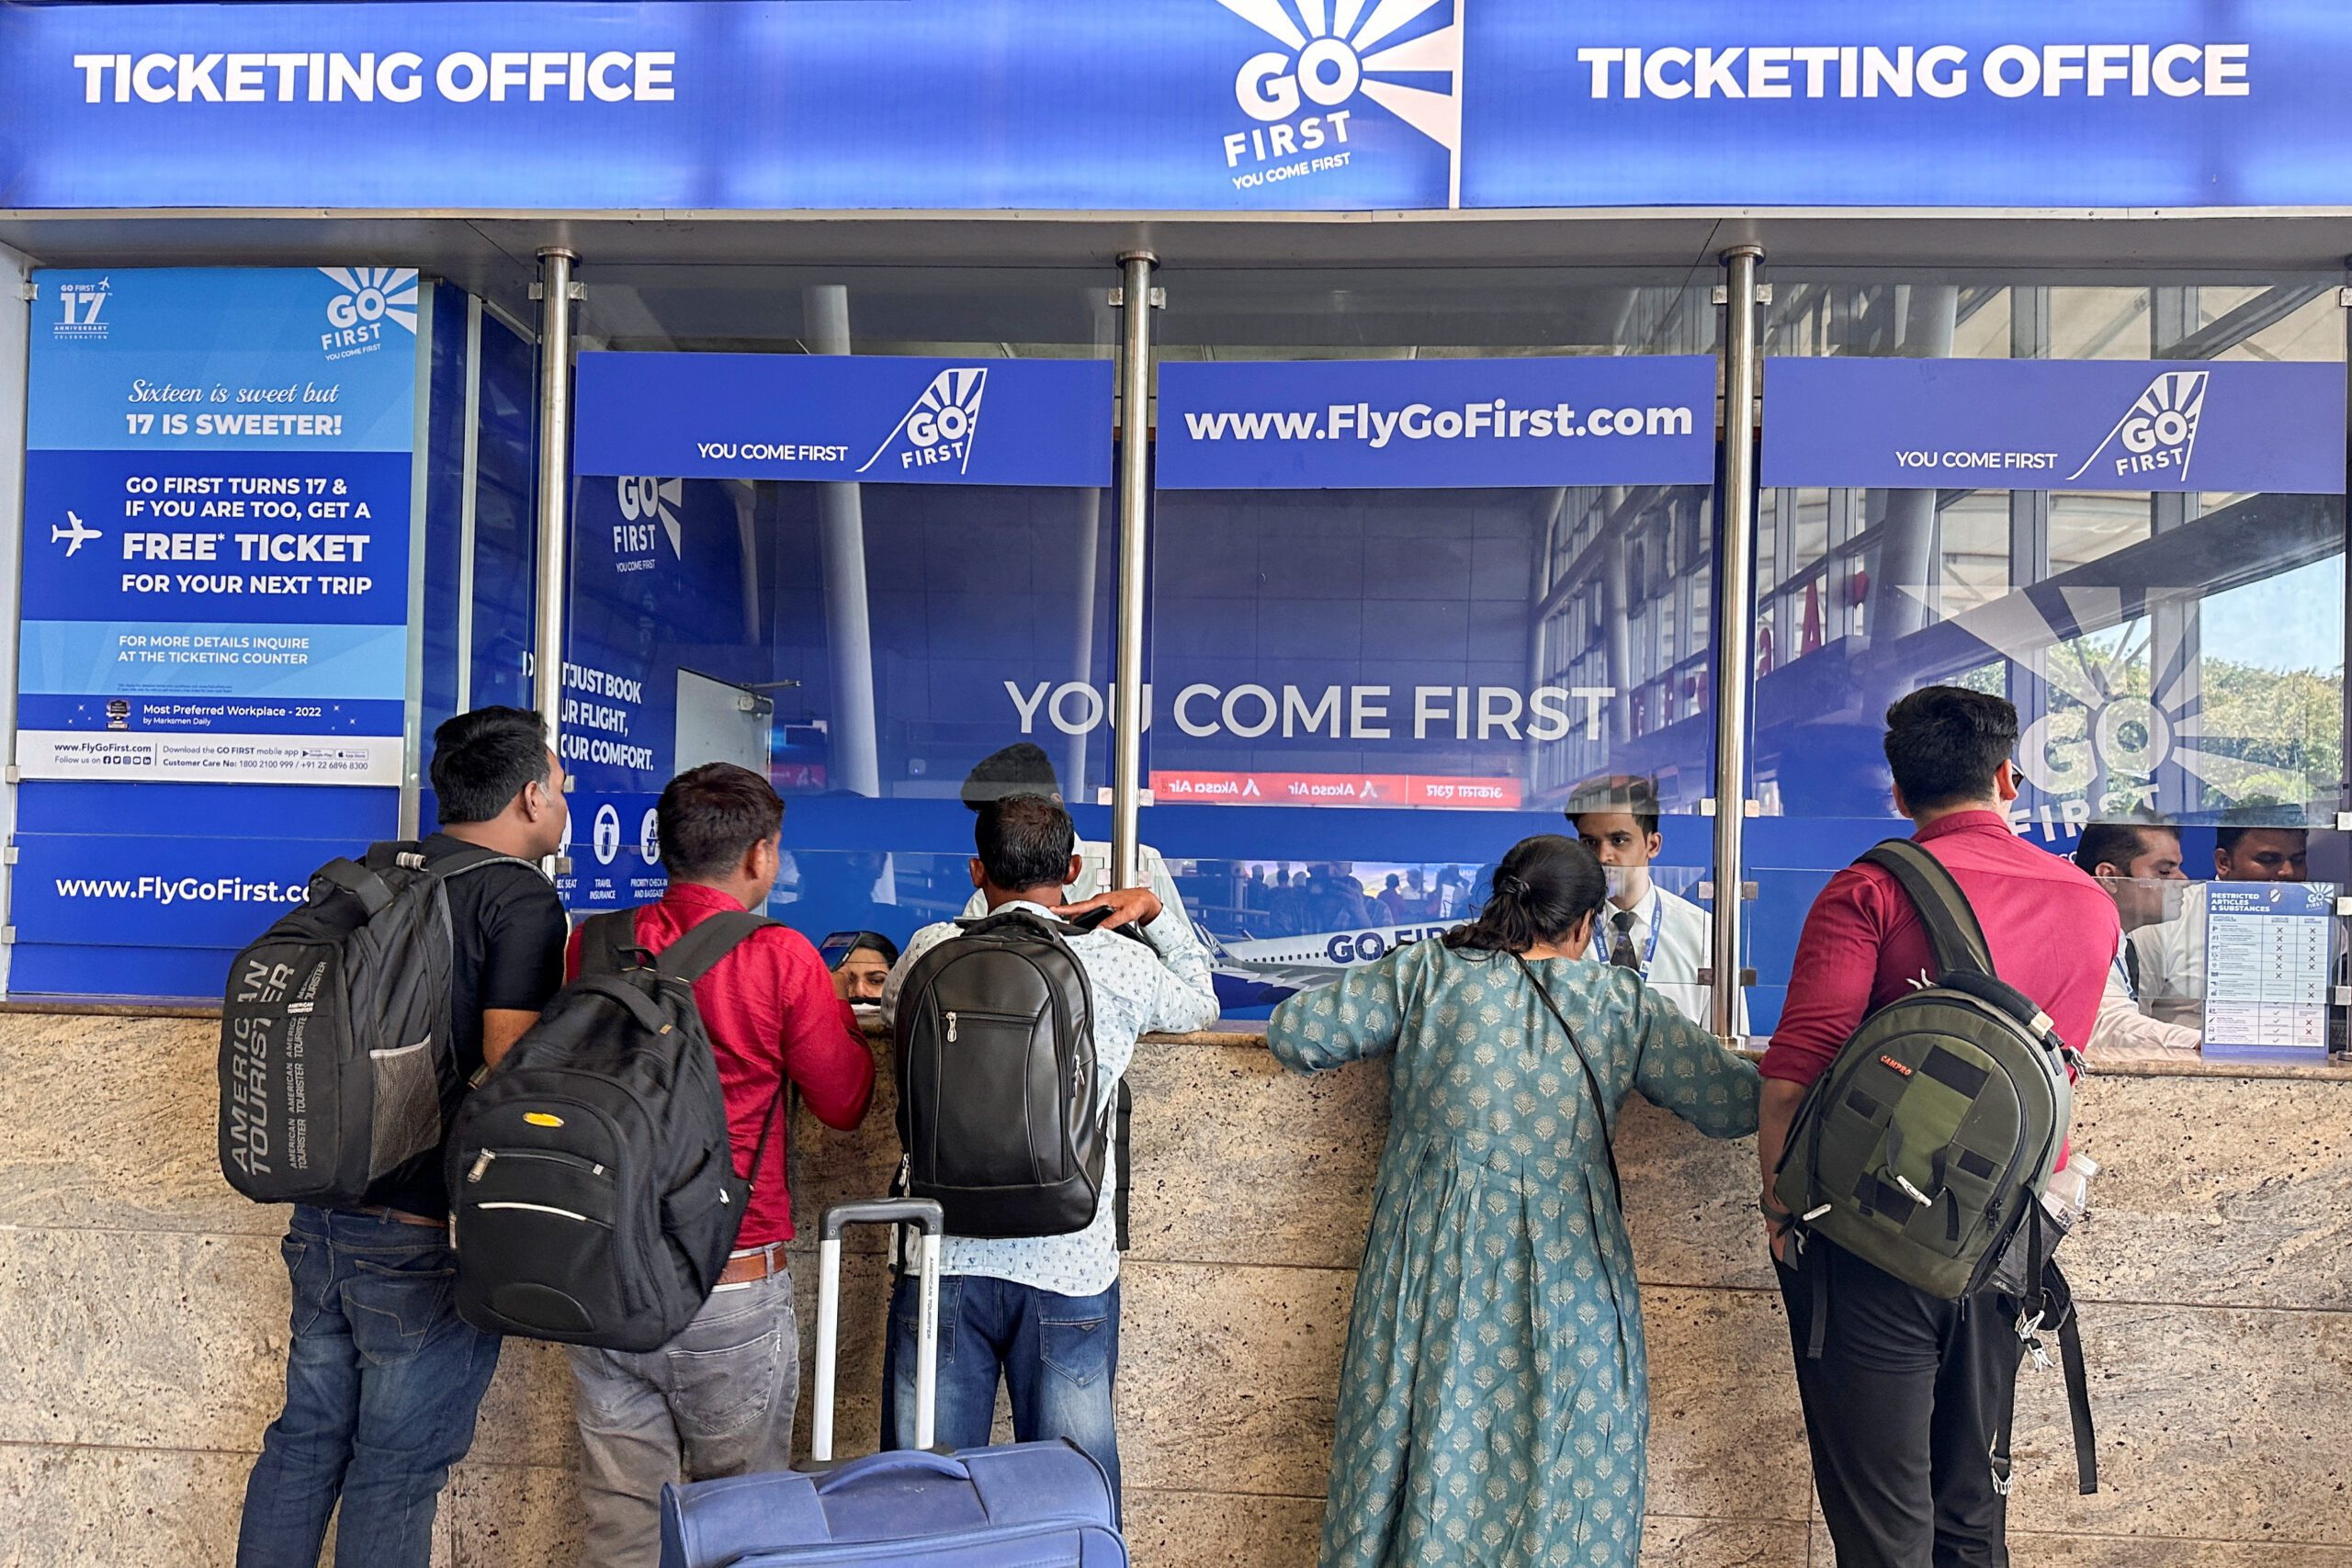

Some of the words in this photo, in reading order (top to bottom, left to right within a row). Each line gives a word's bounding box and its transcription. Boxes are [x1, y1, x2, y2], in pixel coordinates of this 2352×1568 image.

[74, 51, 424, 104] TICKETING
[436, 51, 675, 103] OFFICE
[1236, 39, 1360, 121] GO
[1577, 45, 1968, 99] TICKETING
[1983, 43, 2250, 97] OFFICE
[1224, 110, 1351, 167] FIRST
[1232, 171, 1263, 189] YOU
[1266, 162, 1310, 182] COME
[1312, 152, 1351, 173] FIRST
[326, 288, 386, 329] GO
[321, 322, 381, 350] FIRST
[325, 353, 340, 361] YOU
[341, 348, 362, 358] COME
[362, 343, 381, 353] FIRST
[128, 378, 203, 403] Sixteen
[210, 382, 230, 402] is
[236, 384, 298, 403] sweet
[303, 382, 341, 402] but
[127, 414, 153, 434] 17
[163, 414, 188, 434] IS
[196, 414, 343, 435] SWEETER!
[906, 405, 969, 447] GO
[1184, 399, 1693, 448] www.FlyGoFirst.com
[2121, 410, 2189, 453] GO
[697, 443, 737, 459] YOU
[741, 444, 797, 460] COME
[798, 445, 848, 461] FIRST
[901, 442, 964, 469] FIRST
[1895, 451, 1939, 468] YOU
[1941, 452, 2001, 468] COME
[2005, 453, 2058, 469] FIRST
[2116, 448, 2183, 477] FIRST
[126, 478, 157, 493] GO
[164, 478, 223, 494] FIRST
[228, 478, 300, 495] TURNS
[306, 478, 327, 495] 17
[333, 479, 347, 495] &
[617, 476, 659, 522] GO
[126, 501, 144, 516] IF
[150, 501, 196, 517] YOU
[200, 501, 245, 518] ARE
[251, 502, 302, 521] TOO,
[308, 502, 349, 518] GET
[355, 502, 371, 518] A
[235, 535, 370, 562] TICKET
[613, 524, 656, 553] FIRST
[616, 562, 628, 572] YOU
[628, 560, 642, 572] COME
[642, 558, 656, 570] FIRST
[122, 574, 170, 592] FOR
[176, 575, 243, 593] YOUR
[250, 576, 312, 594] NEXT
[317, 577, 373, 595] TRIP
[119, 636, 146, 647] FOR
[151, 636, 190, 648] MORE
[194, 637, 249, 649] DETAILS
[254, 637, 310, 649] INQUIRE
[118, 651, 136, 661] AT
[138, 651, 164, 662] THE
[168, 651, 239, 663] TICKETING
[243, 653, 309, 664] COUNTER
[570, 664, 604, 694] JUST
[605, 673, 642, 704] BOOK
[143, 705, 170, 714] Most
[173, 705, 224, 716] Preferred
[227, 705, 286, 717] Workplace
[295, 707, 322, 716] 2022
[193, 717, 211, 726] Daily
[581, 703, 628, 737] FLIGHT,
[1173, 682, 1389, 739] COME
[1414, 685, 1616, 740] FIRST
[54, 742, 152, 753] www.FlyGoFirst.com
[256, 747, 282, 755] mobile
[591, 739, 654, 772] COMFORT.
[2018, 696, 2170, 795] GO
[202, 759, 220, 767] Care
[349, 761, 368, 770] 8300
[590, 890, 616, 899] INSURANCE
[594, 878, 612, 888] TRAVEL
[2211, 892, 2260, 900] RESTRICTED
[2307, 892, 2324, 904] GO
[1327, 931, 1385, 964] GO
[1881, 1055, 1912, 1076] CAMPRO
[287, 1062, 295, 1113] AMERICAN
[295, 1063, 306, 1113] TOURISTER
[288, 1118, 298, 1169] AMERICAN
[297, 1118, 308, 1170] TOURISTER
